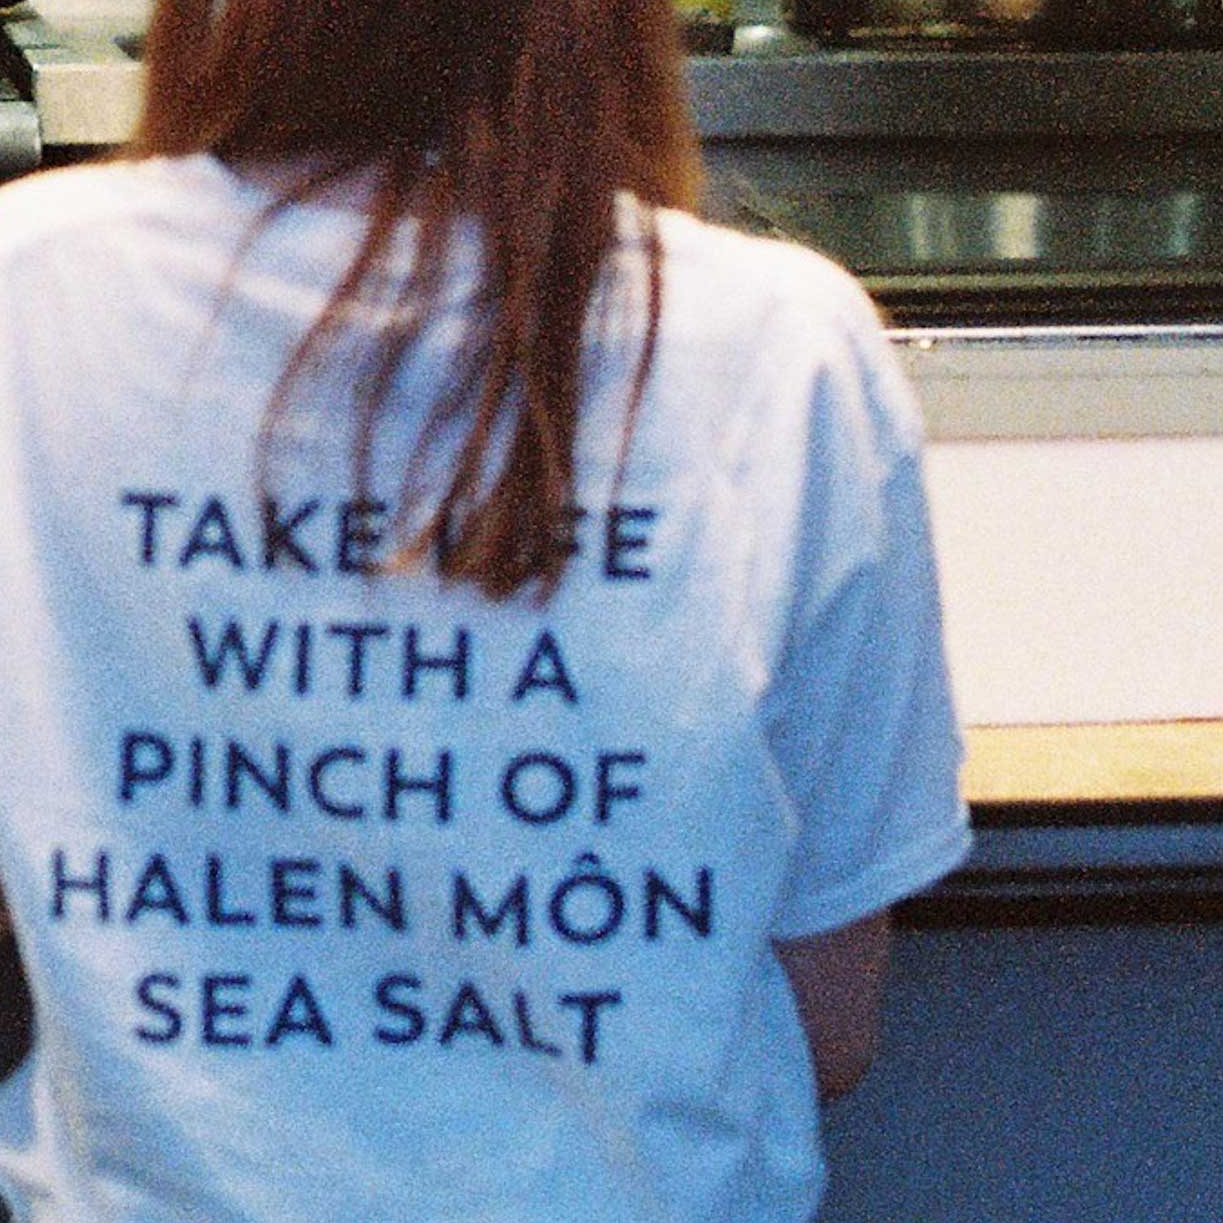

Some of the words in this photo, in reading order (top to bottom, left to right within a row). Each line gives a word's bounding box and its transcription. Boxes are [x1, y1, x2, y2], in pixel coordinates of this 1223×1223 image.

[122, 492, 388, 577] TAKE
[188, 618, 474, 703] WITH
[511, 627, 584, 706] A
[118, 728, 458, 826] PINCH
[497, 748, 648, 831] OF
[50, 848, 414, 937] HALEN
[449, 851, 718, 950] MÔN
[137, 970, 339, 1052] SEA
[369, 970, 626, 1069] SALT
